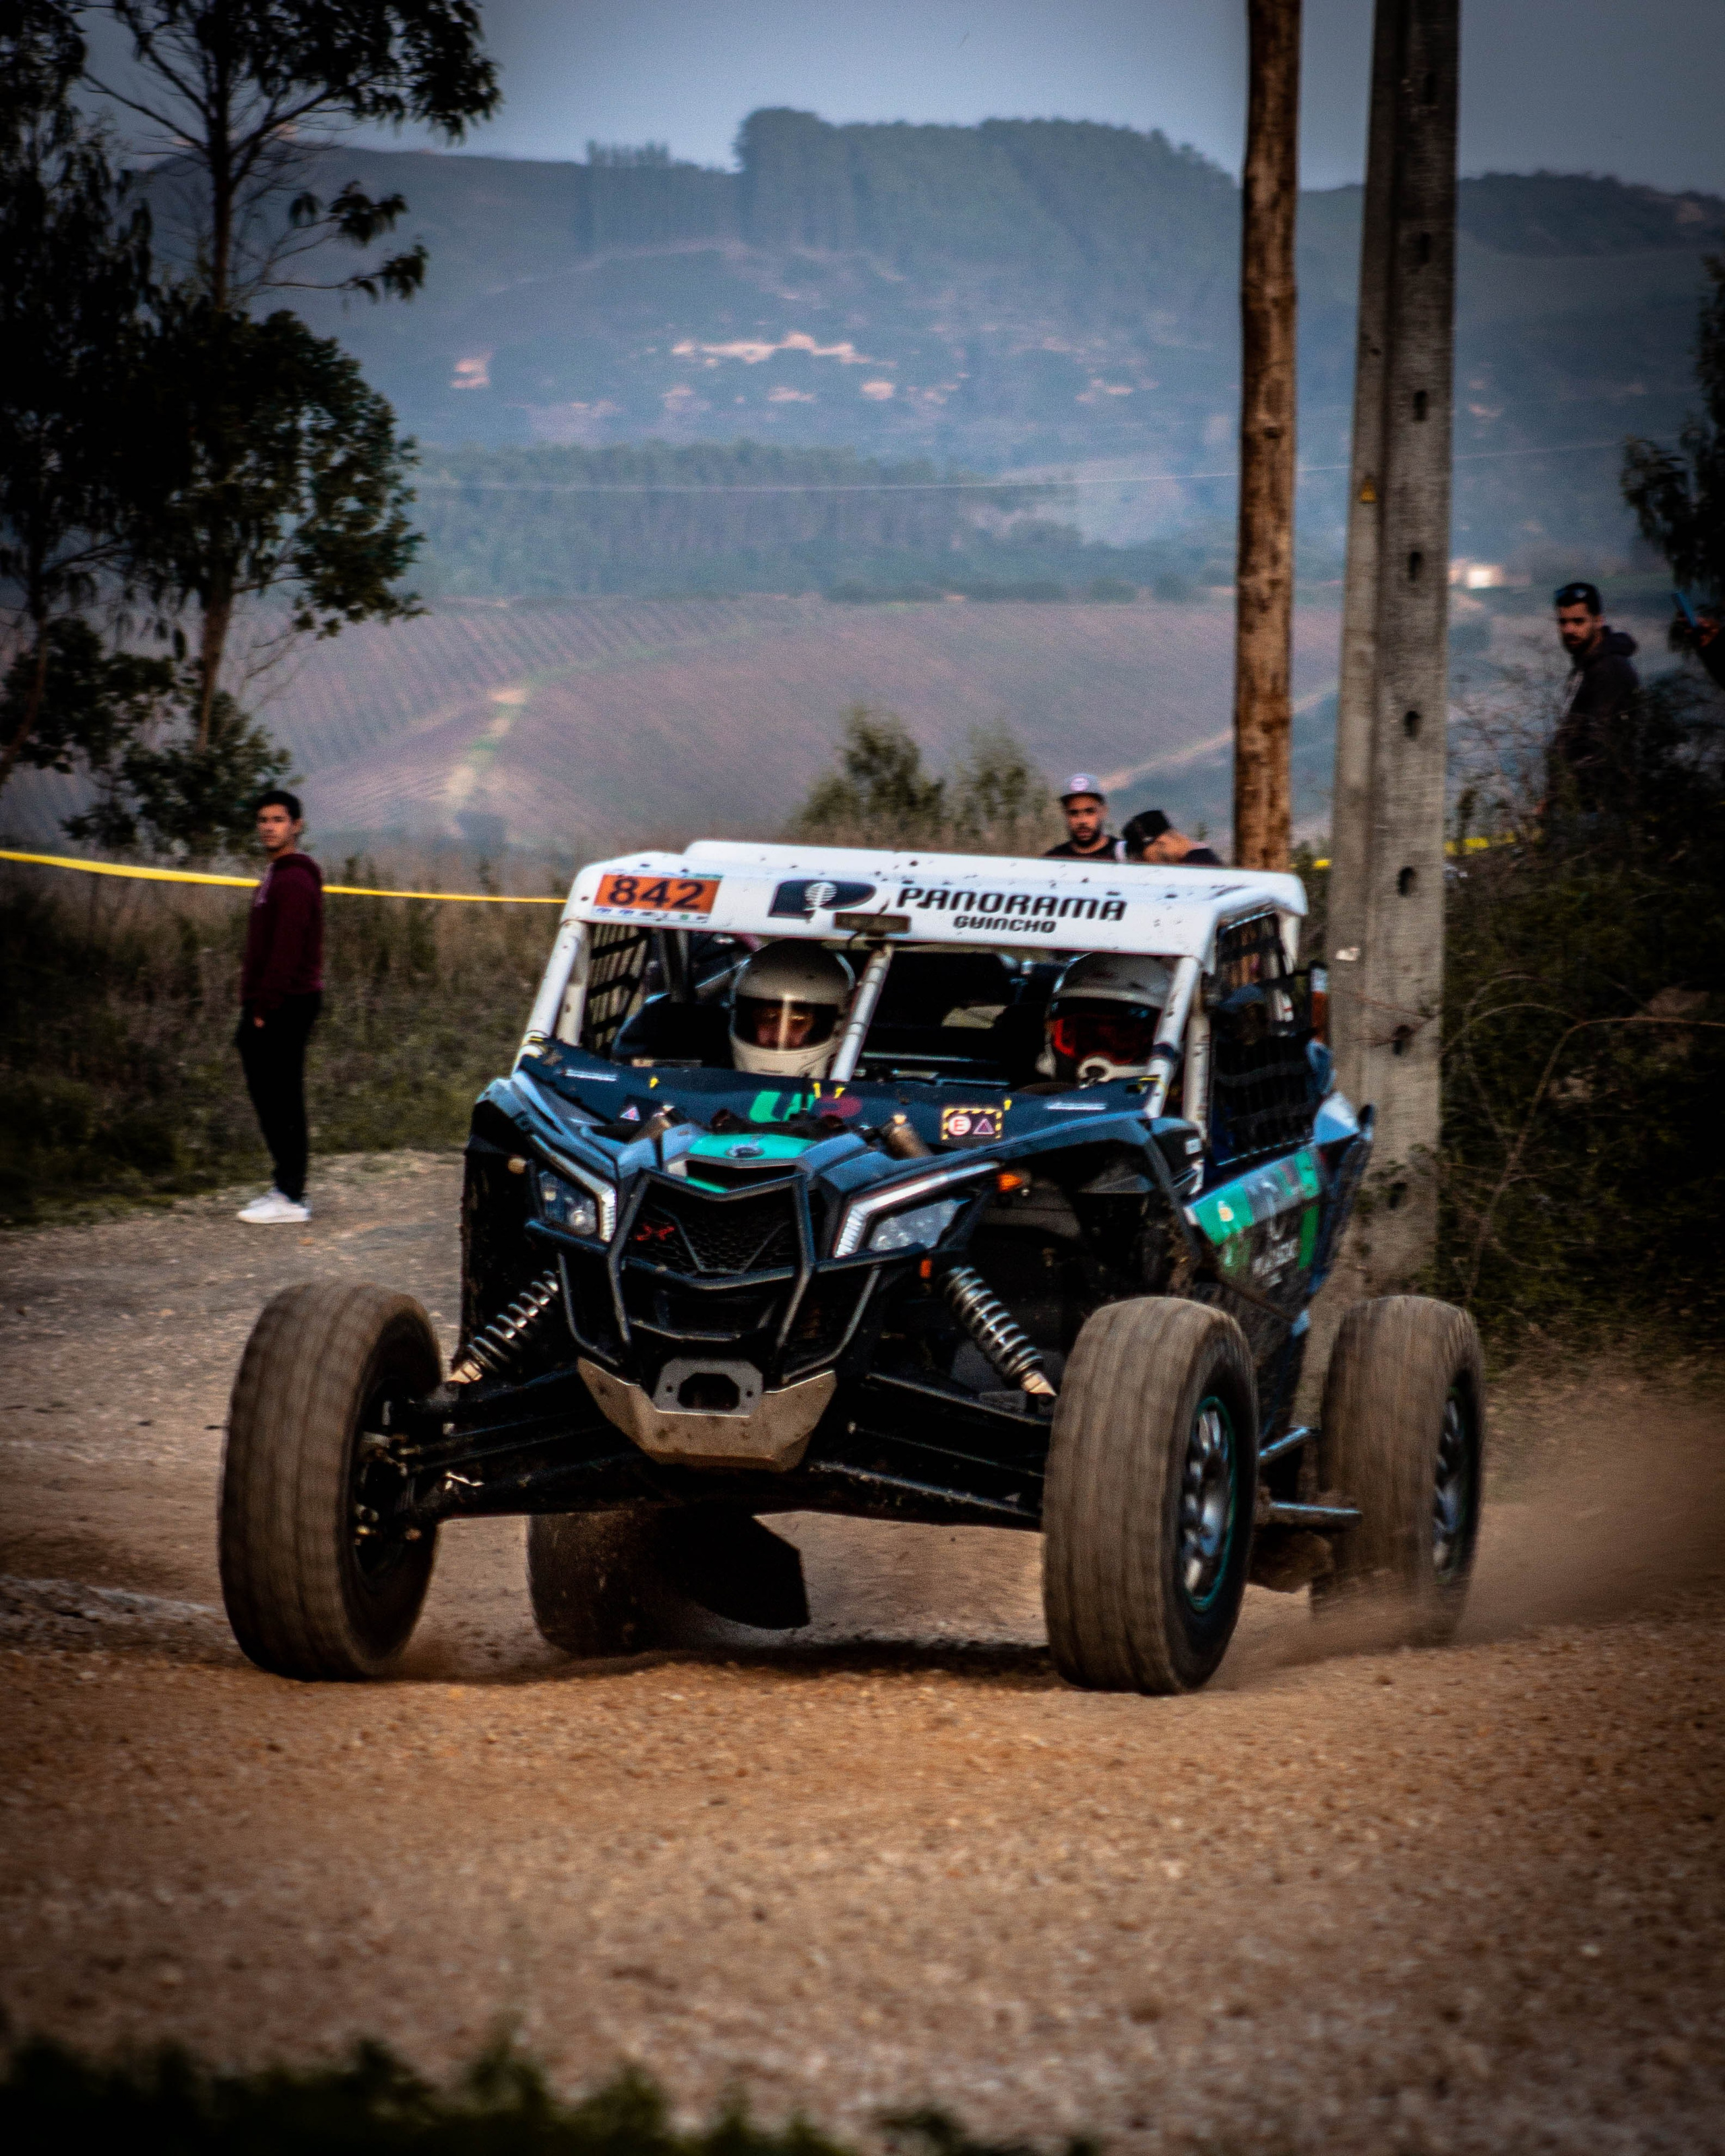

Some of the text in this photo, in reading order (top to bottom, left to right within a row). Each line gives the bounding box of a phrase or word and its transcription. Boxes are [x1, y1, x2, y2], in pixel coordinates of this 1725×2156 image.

[608, 877, 705, 911] 842
[897, 887, 1127, 922] PANORAMA
[953, 1119, 966, 1132] E
